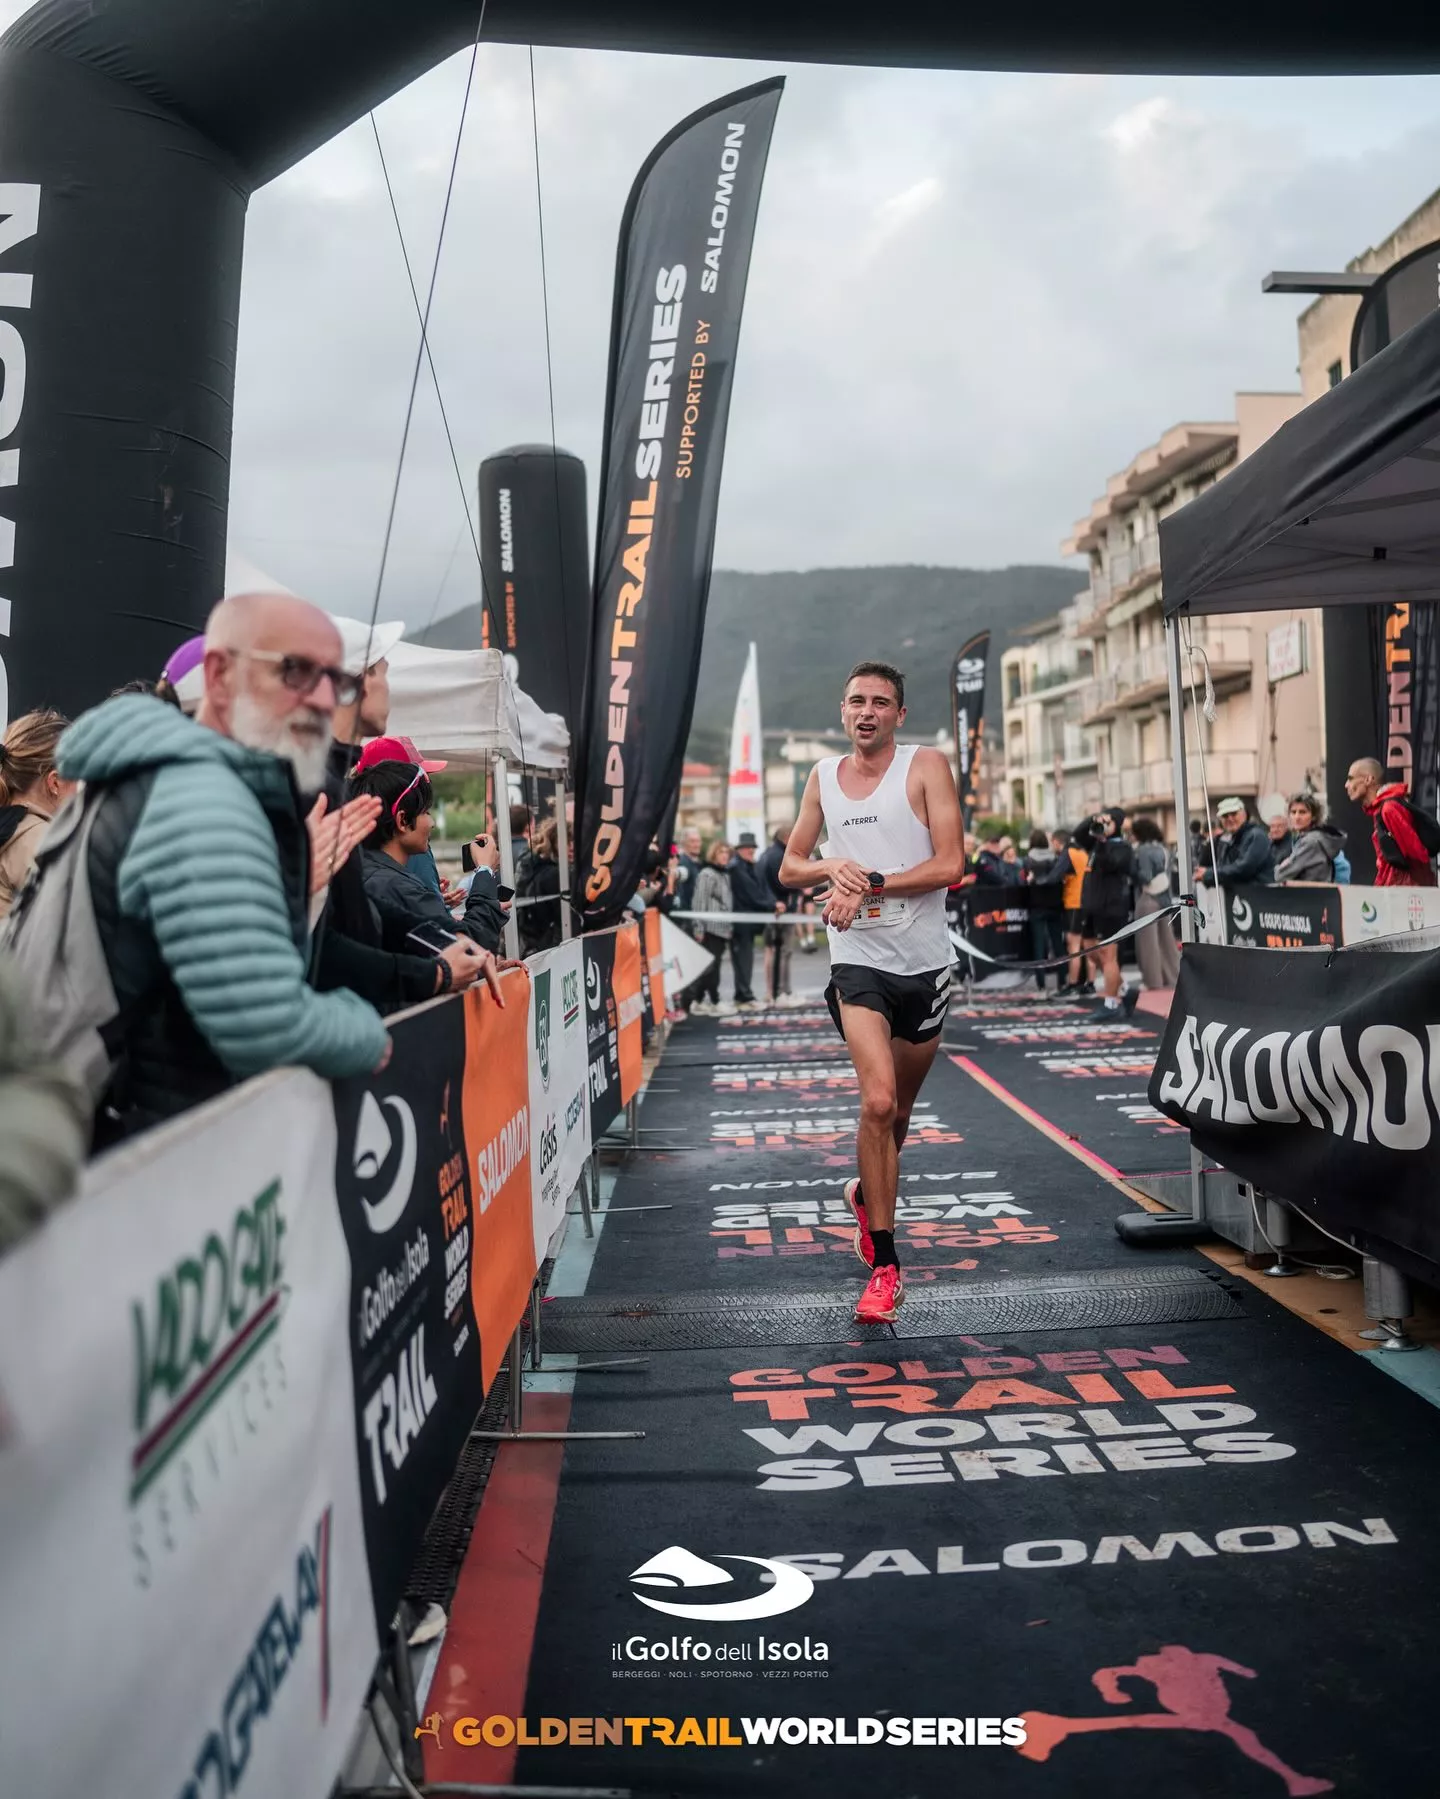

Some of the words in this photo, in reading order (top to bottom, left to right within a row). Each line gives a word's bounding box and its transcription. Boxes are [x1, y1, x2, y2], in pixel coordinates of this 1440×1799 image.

[700, 122, 746, 294] SALOMON
[676, 352, 706, 478] SUPPORTED
[695, 319, 711, 345] BY
[499, 488, 514, 573] SALOMON
[851, 815, 878, 826] TERREX
[441, 1181, 469, 1240] TRAIL
[709, 1171, 999, 1191] SALMON
[713, 1191, 1016, 1217] SEIES
[444, 1225, 469, 1280] WORLD
[444, 1260, 468, 1320] SERIES
[728, 1345, 1191, 1387] GOLDEN
[732, 1369, 1238, 1421] TRAIL
[363, 1322, 438, 1505] TRAIL
[741, 1402, 1258, 1456] WORLD
[755, 1432, 1298, 1491] SERIES
[759, 1517, 1400, 1583] SALOMON
